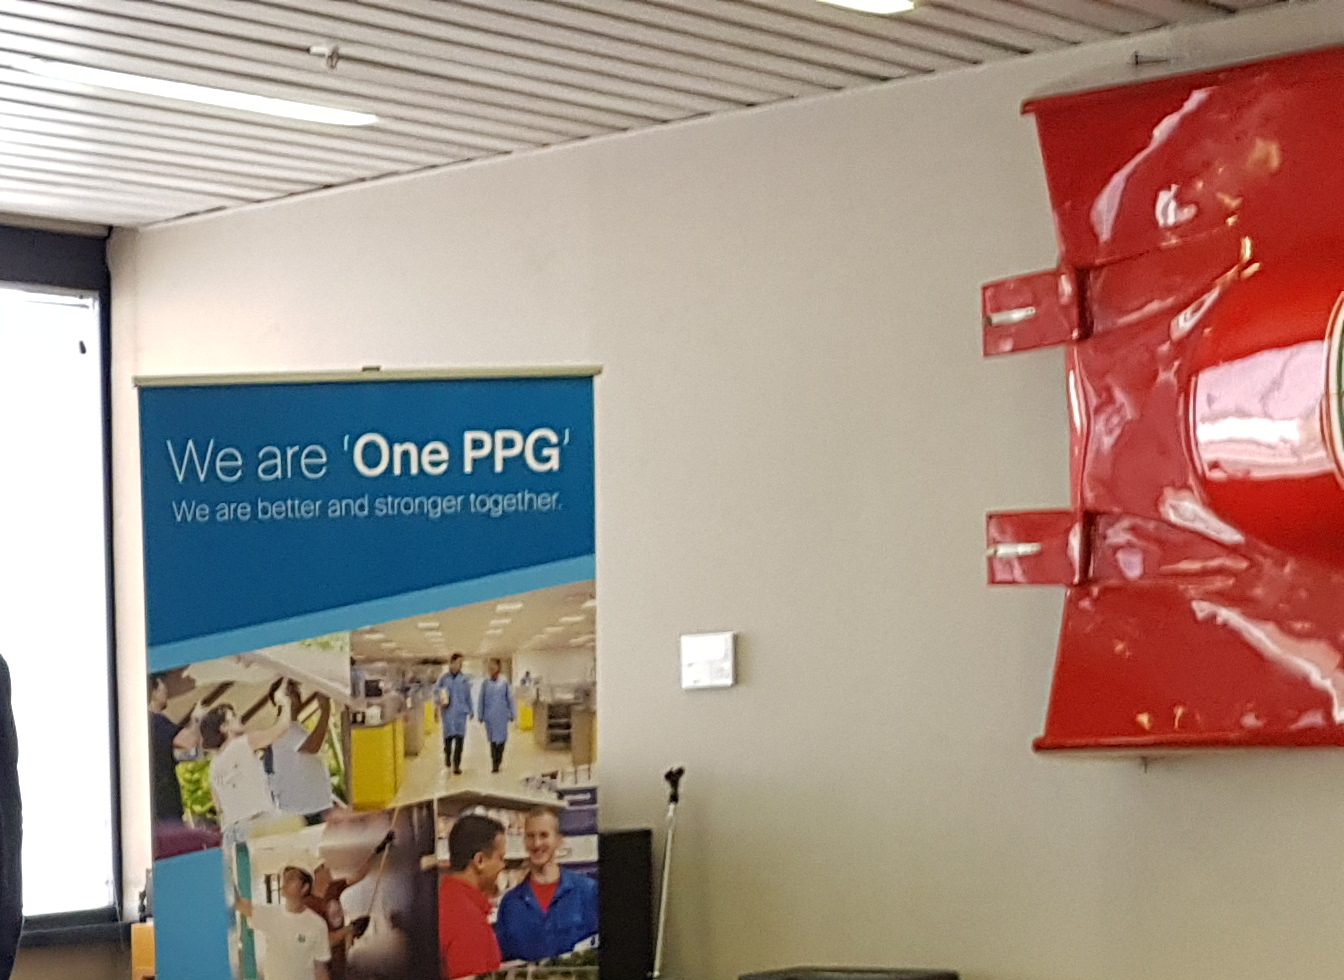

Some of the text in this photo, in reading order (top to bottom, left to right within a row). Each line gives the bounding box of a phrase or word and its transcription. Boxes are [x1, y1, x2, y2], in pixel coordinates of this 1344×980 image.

[166, 438, 243, 483] We
[258, 445, 327, 481] are
[172, 490, 562, 522] We are better and stronger together.
